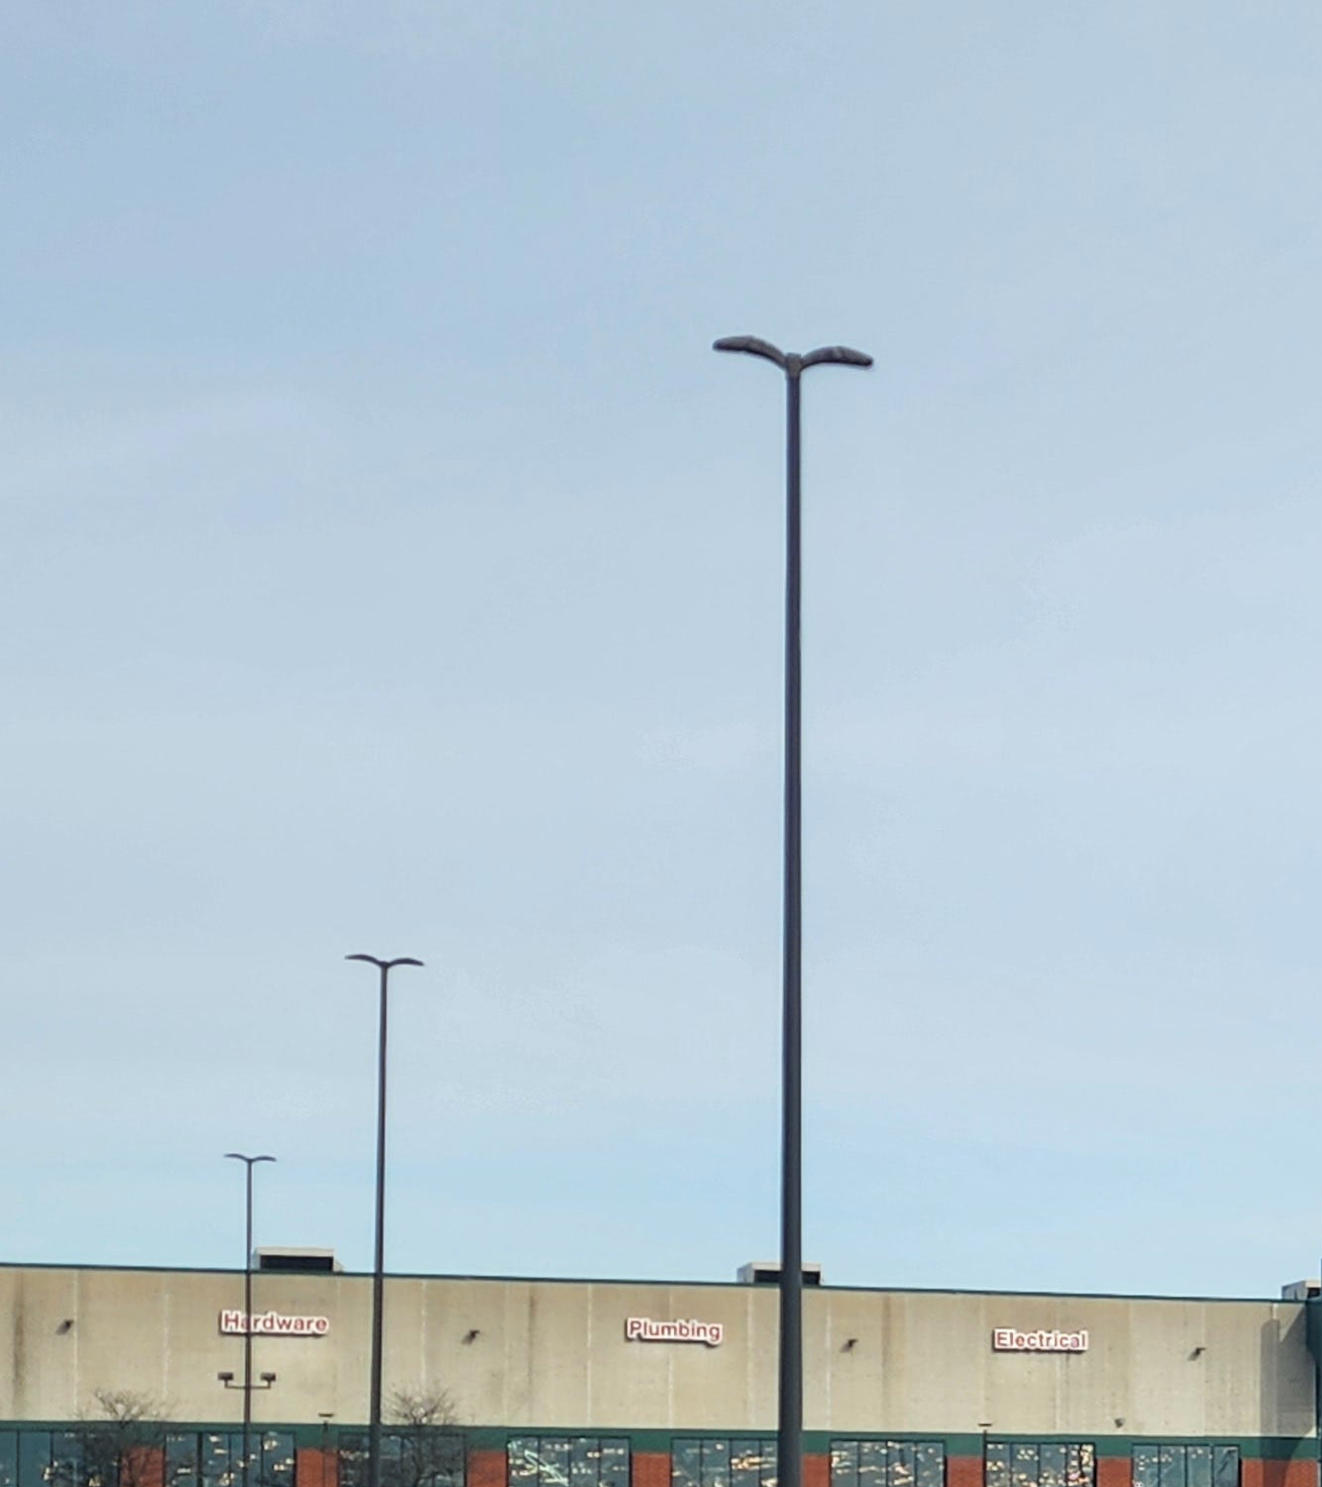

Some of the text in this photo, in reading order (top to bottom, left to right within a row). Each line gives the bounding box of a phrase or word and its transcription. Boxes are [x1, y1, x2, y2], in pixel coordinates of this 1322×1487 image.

[221, 1310, 329, 1334] Hardware
[627, 1318, 723, 1345] Plumbing
[994, 1328, 1088, 1351] Electrical
